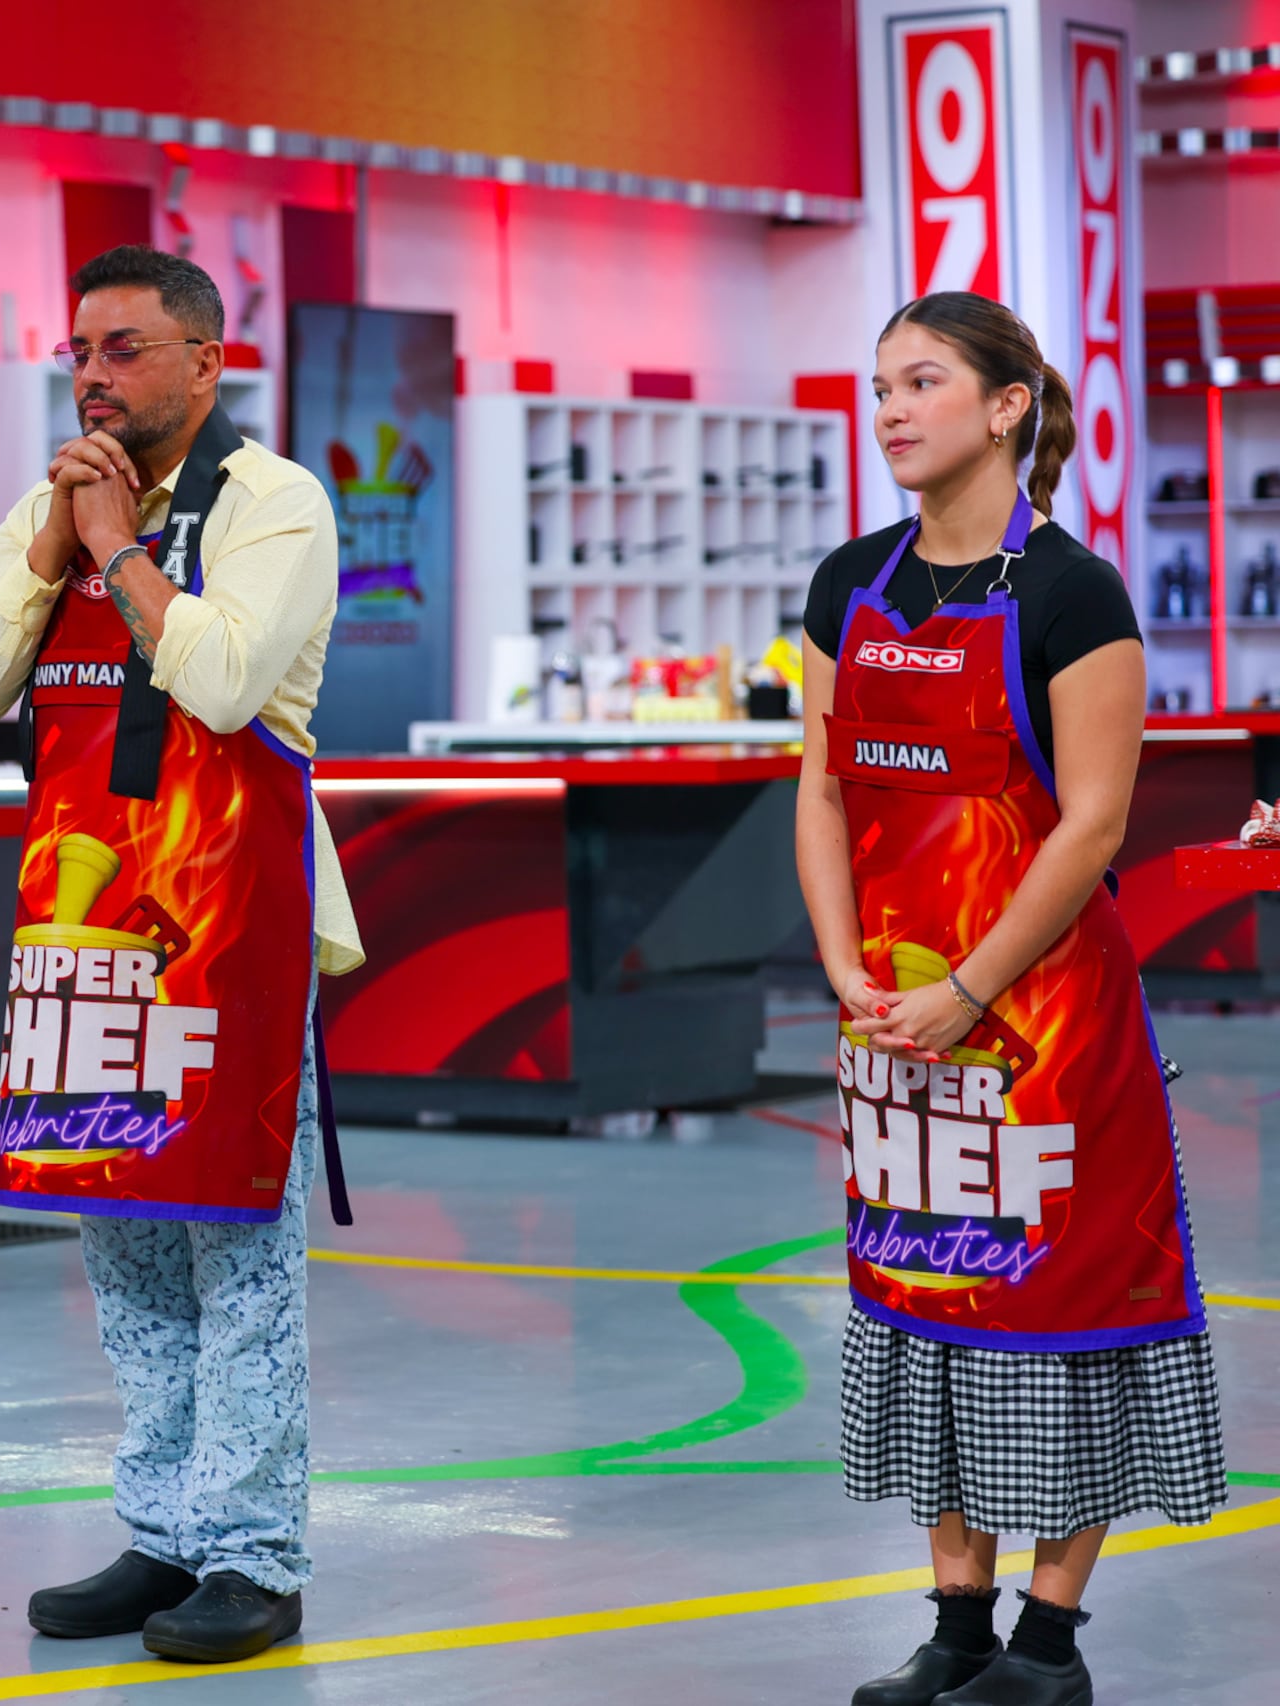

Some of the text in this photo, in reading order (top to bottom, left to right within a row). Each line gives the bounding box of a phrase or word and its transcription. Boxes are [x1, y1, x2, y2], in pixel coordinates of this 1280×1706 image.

[855, 741, 949, 772] JULIANA
[0, 998, 218, 1101] HEF
[839, 1035, 1006, 1119] SUPER
